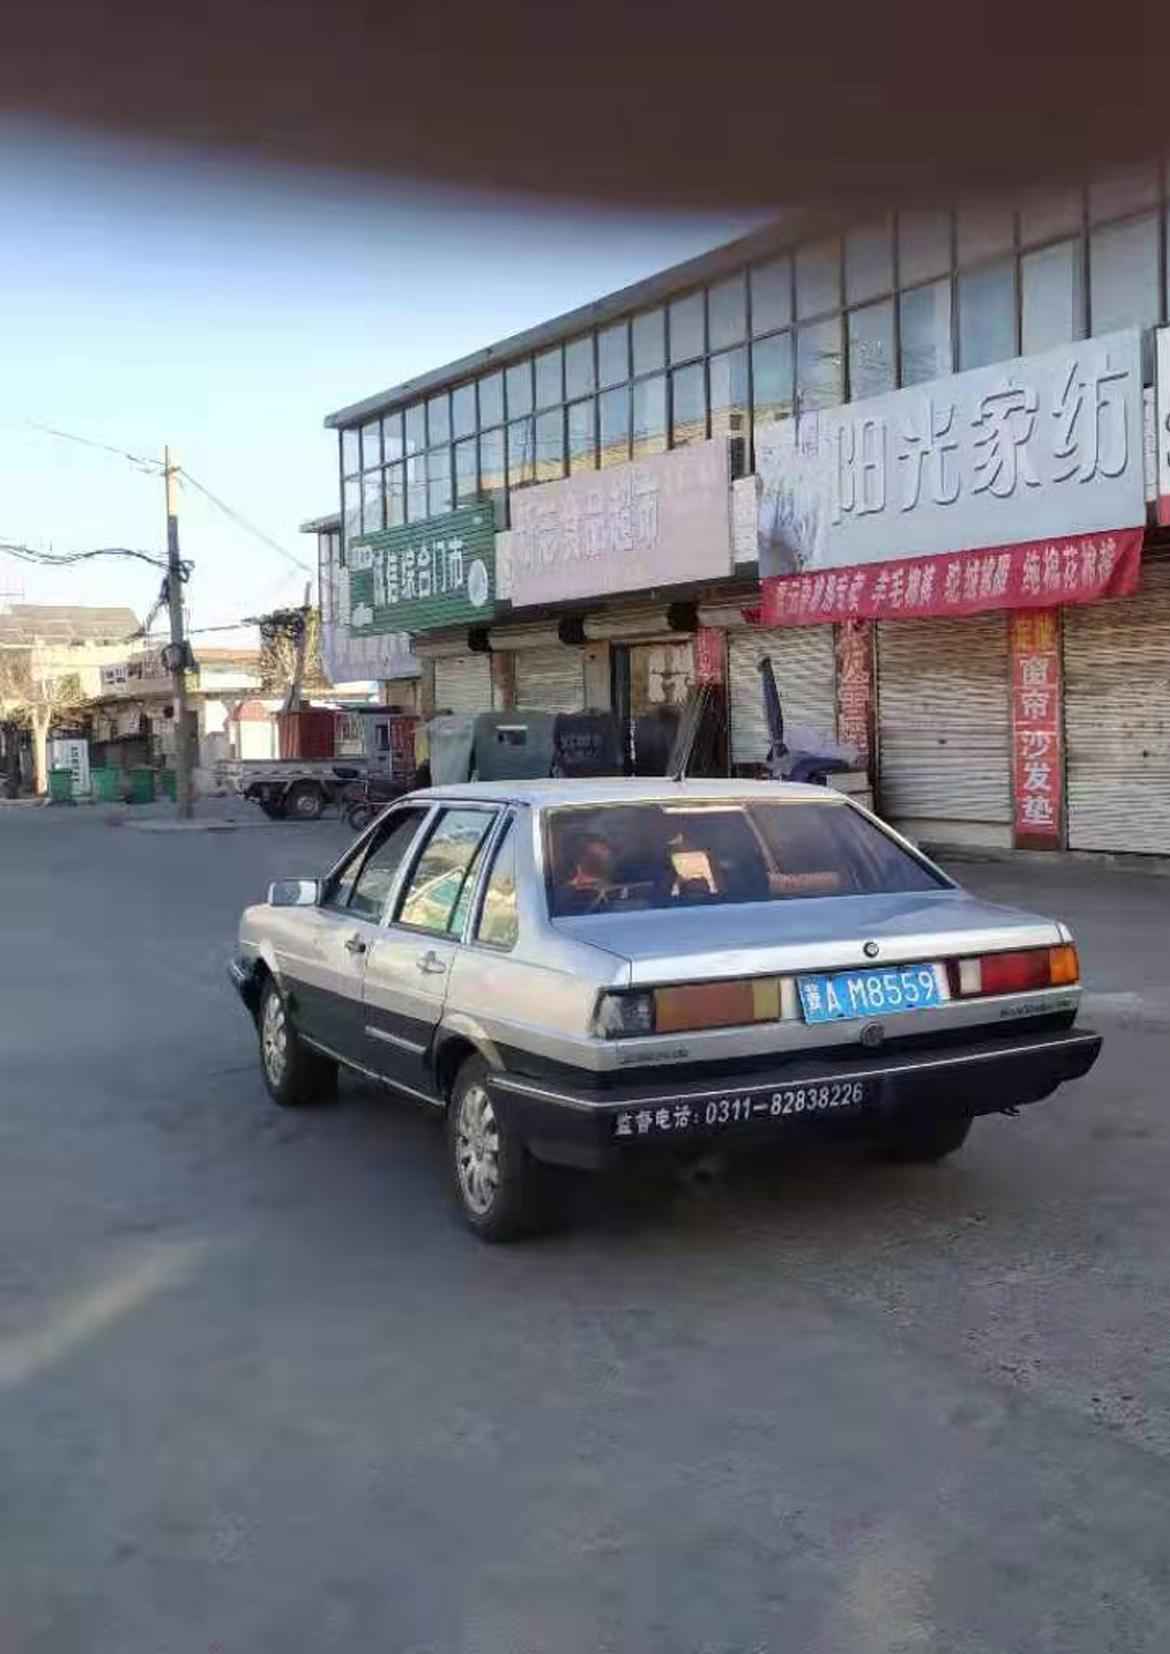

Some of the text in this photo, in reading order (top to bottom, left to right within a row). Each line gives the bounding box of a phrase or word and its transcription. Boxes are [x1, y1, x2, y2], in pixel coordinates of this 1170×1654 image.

[832, 354, 1130, 526] 阳光家纺
[847, 971, 934, 1010] M8559
